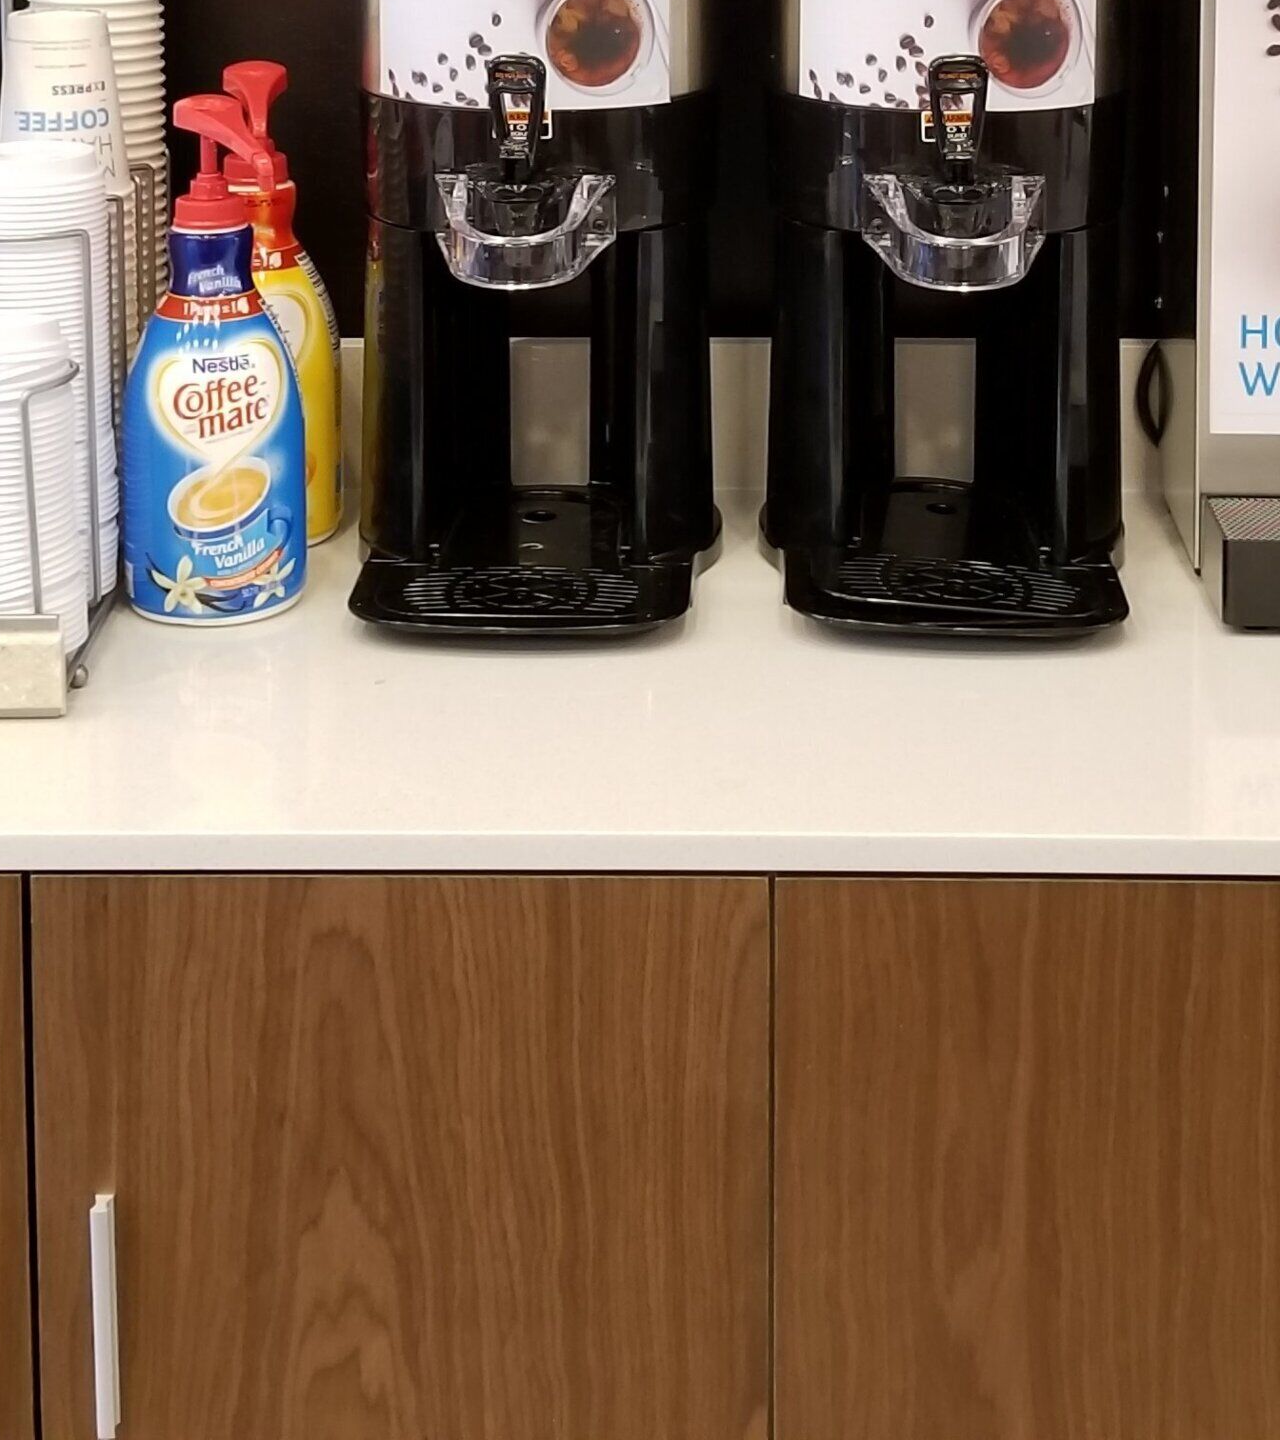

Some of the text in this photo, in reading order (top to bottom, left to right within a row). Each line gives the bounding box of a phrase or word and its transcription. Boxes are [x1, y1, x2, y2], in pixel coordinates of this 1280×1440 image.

[187, 264, 225, 285] French
[199, 275, 242, 293] Vanilla
[191, 534, 244, 556] French
[214, 538, 265, 569] Vanilla
